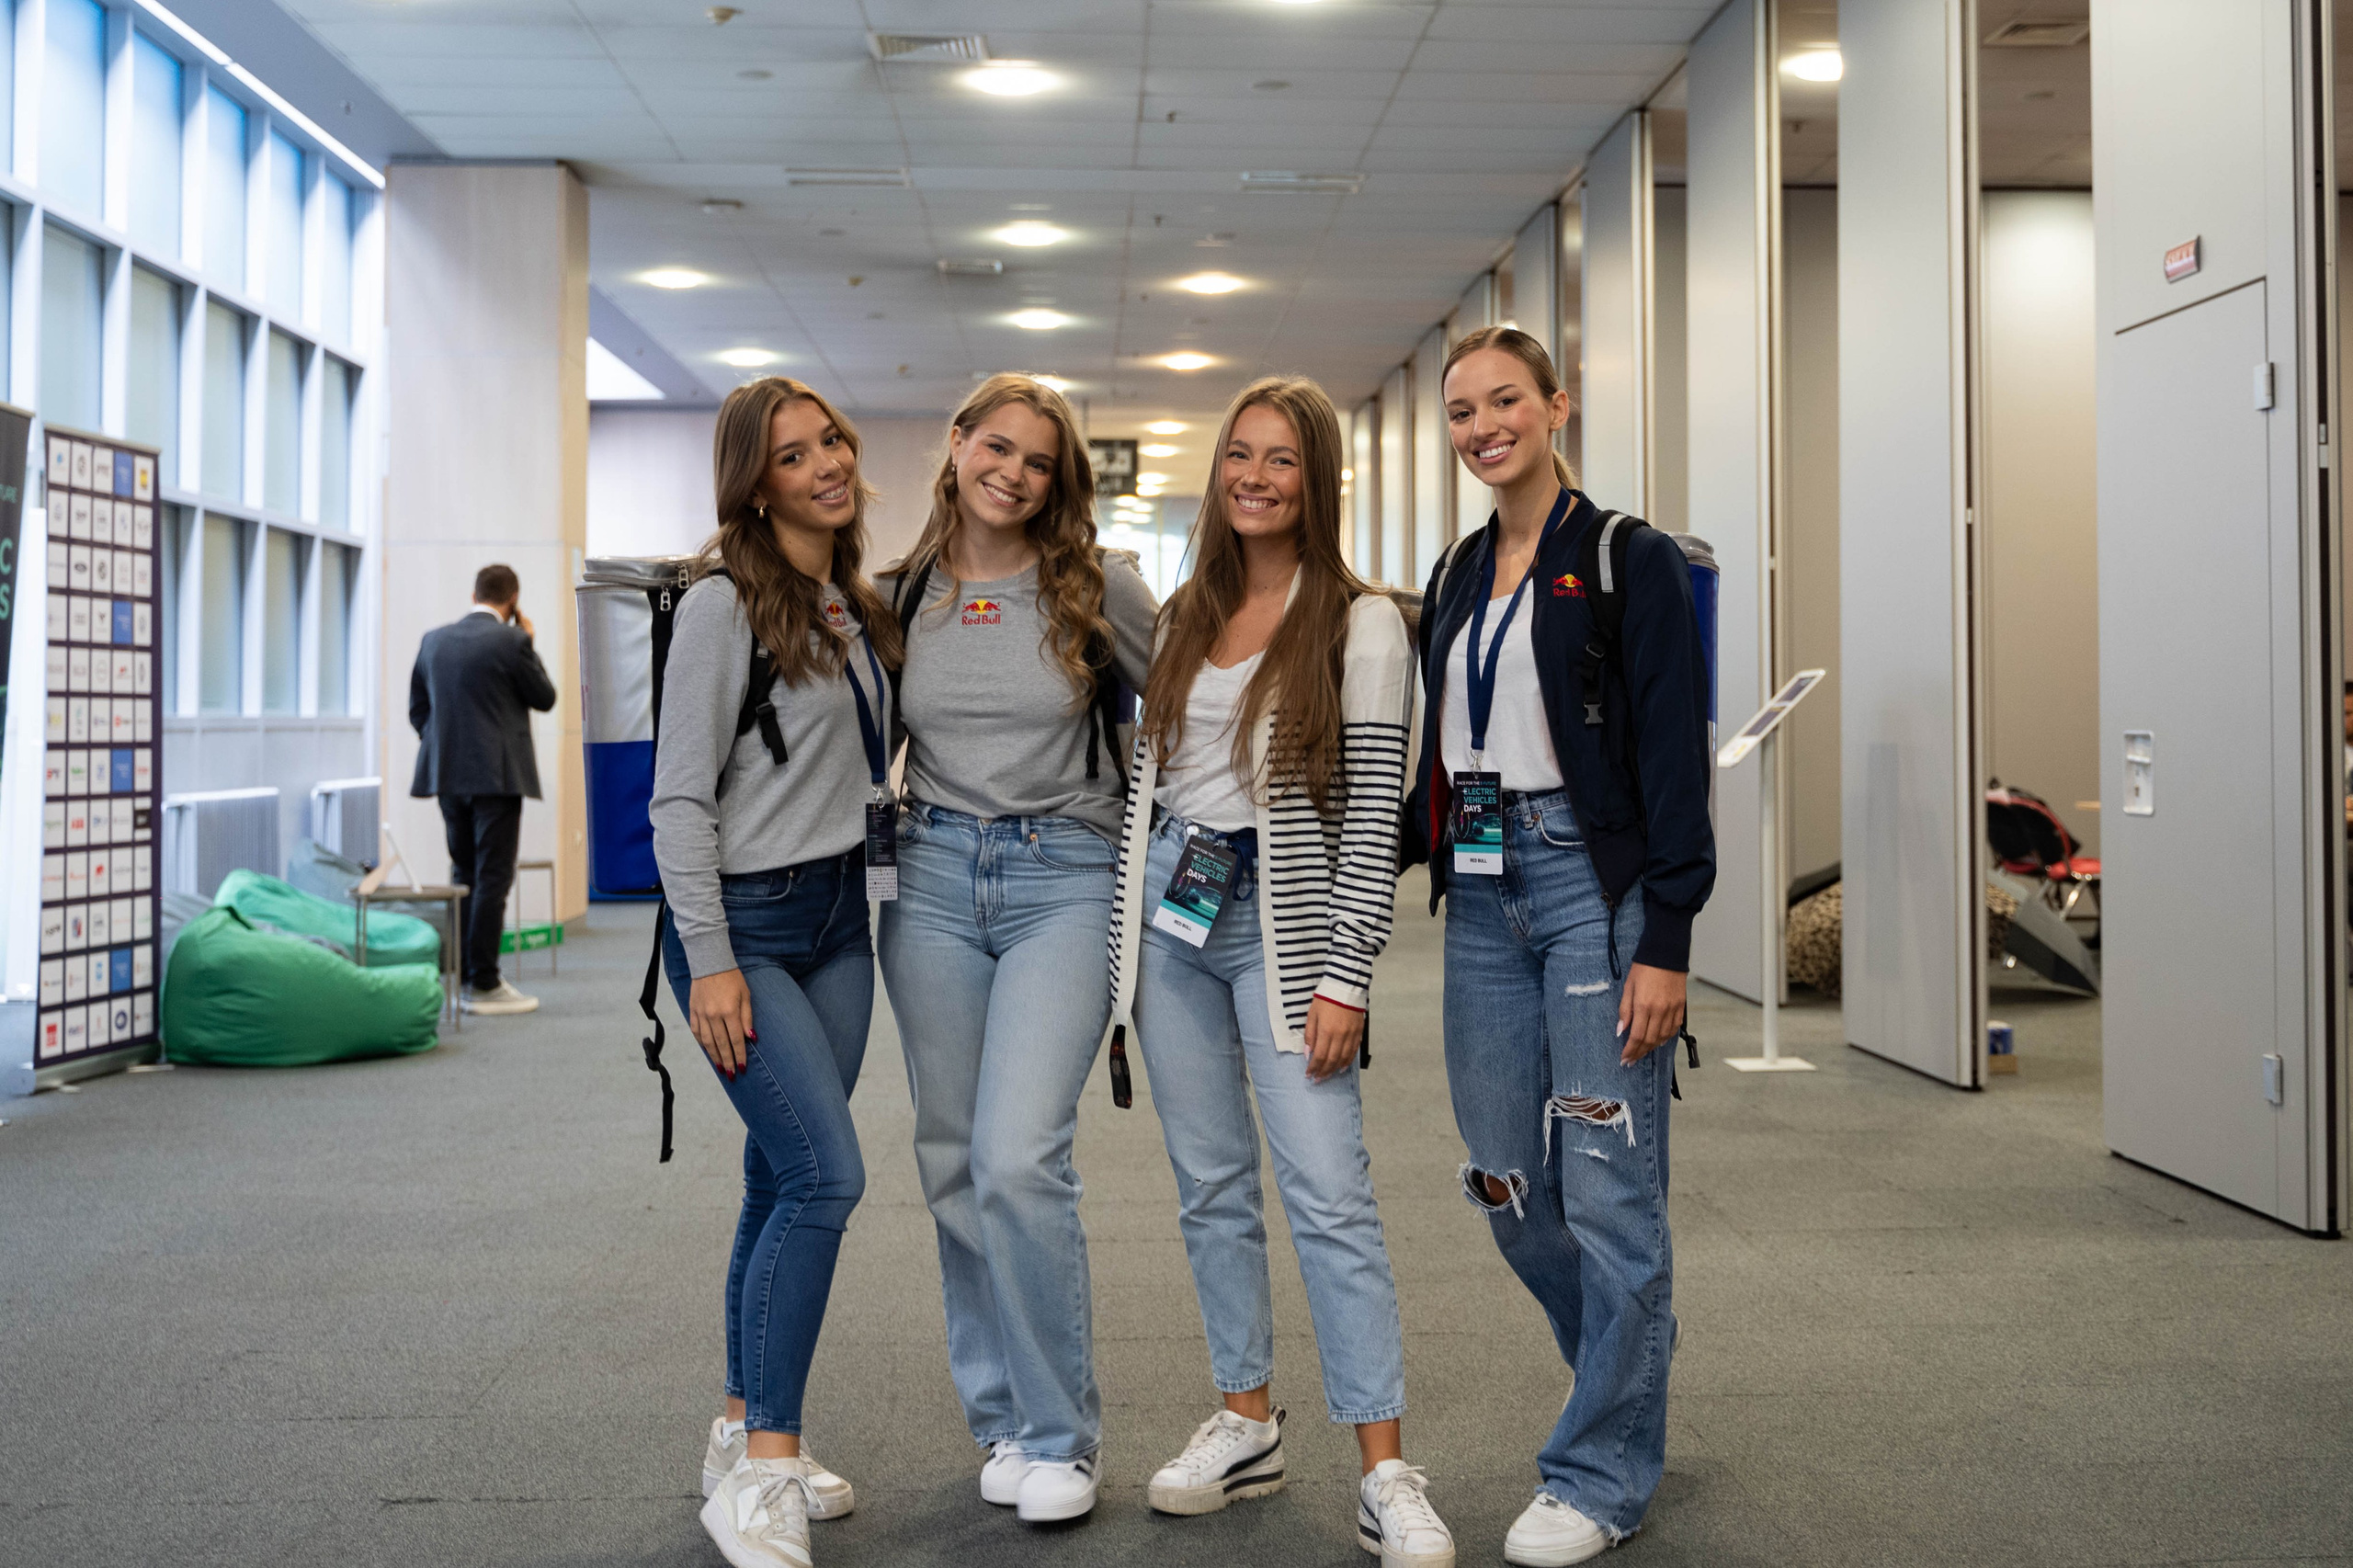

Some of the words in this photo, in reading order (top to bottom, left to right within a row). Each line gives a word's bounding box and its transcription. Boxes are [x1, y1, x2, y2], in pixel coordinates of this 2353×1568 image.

[1553, 588, 1570, 597] Red
[961, 614, 981, 625] Red
[982, 613, 1001, 625] Bull
[1463, 787, 1496, 796] ELECTRIC
[1463, 796, 1497, 804] VEHICLES
[1463, 804, 1482, 812] DAYS
[1193, 853, 1230, 875] ELECTRIC
[1187, 868, 1208, 883] DAYS
[1190, 860, 1227, 883] VEHICLES
